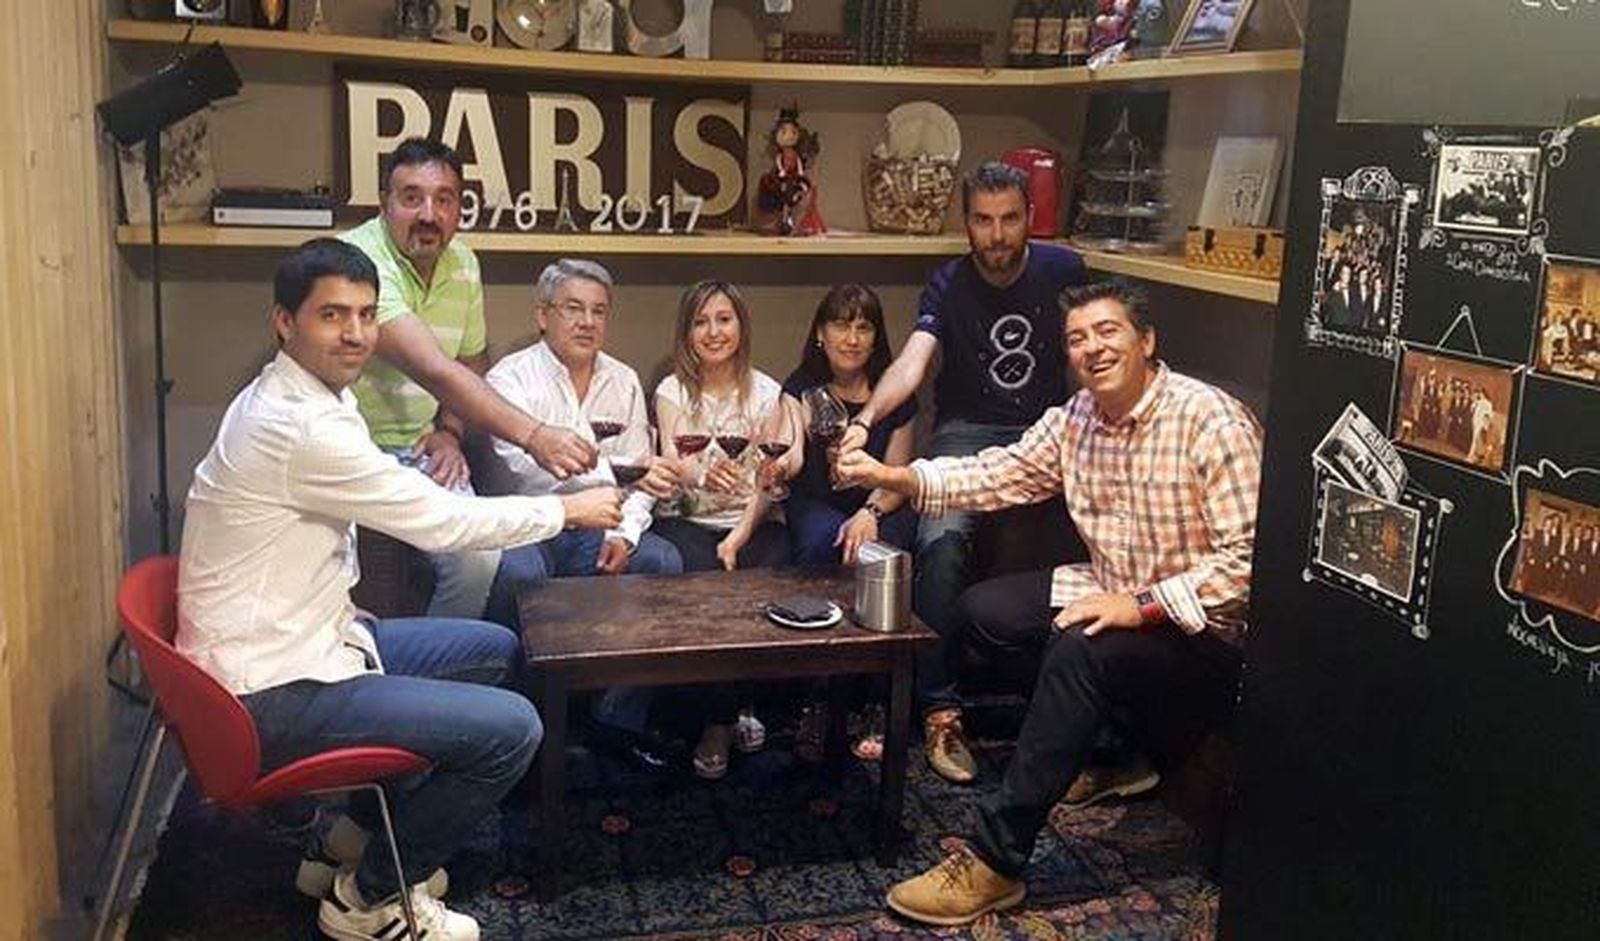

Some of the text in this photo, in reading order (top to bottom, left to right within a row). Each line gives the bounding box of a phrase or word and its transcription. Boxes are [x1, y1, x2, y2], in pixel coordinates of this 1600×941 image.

[347, 82, 746, 216] PARIS
[458, 190, 703, 234] 976 2017
